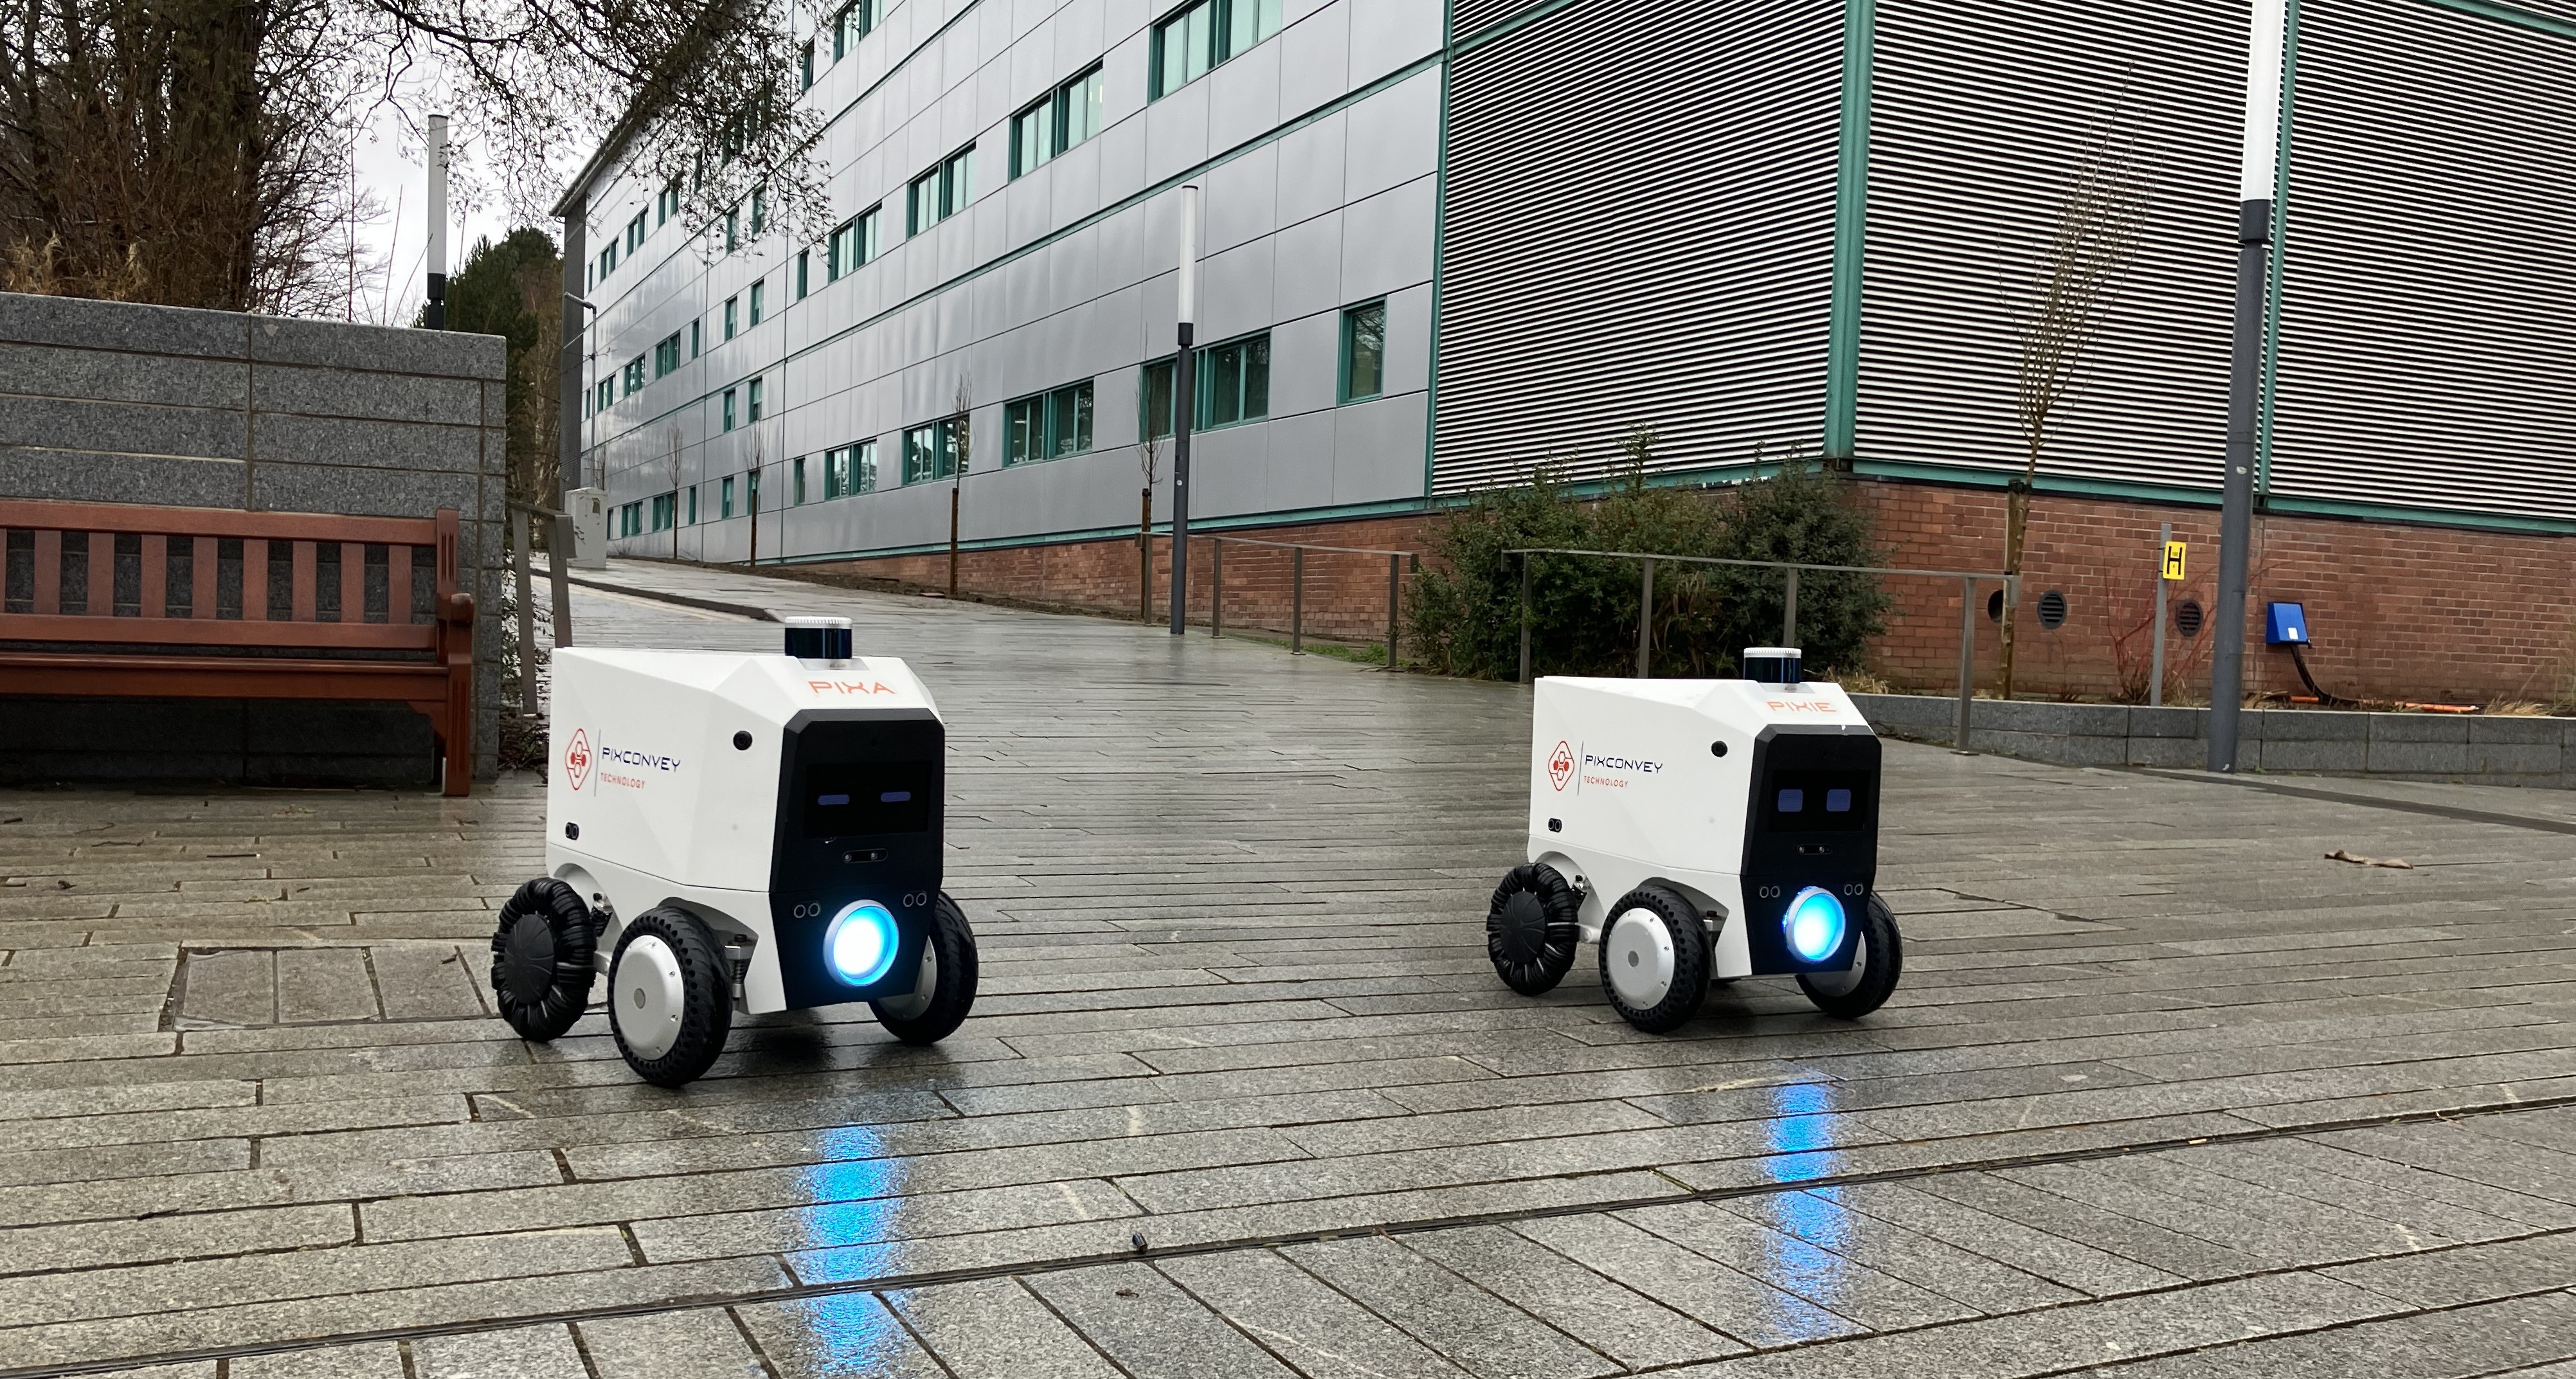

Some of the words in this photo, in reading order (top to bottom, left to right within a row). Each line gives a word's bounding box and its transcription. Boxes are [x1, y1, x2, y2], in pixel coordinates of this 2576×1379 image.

[2166, 546, 2183, 575] H
[808, 681, 895, 694] PIXA
[1767, 701, 1837, 712] PIXIE
[602, 746, 681, 773] PIXCONVEY
[1585, 755, 1663, 773] PIXCONVEY
[600, 772, 645, 789] TECHNOLOGY
[1583, 775, 1628, 788] TECHNOLOGY
